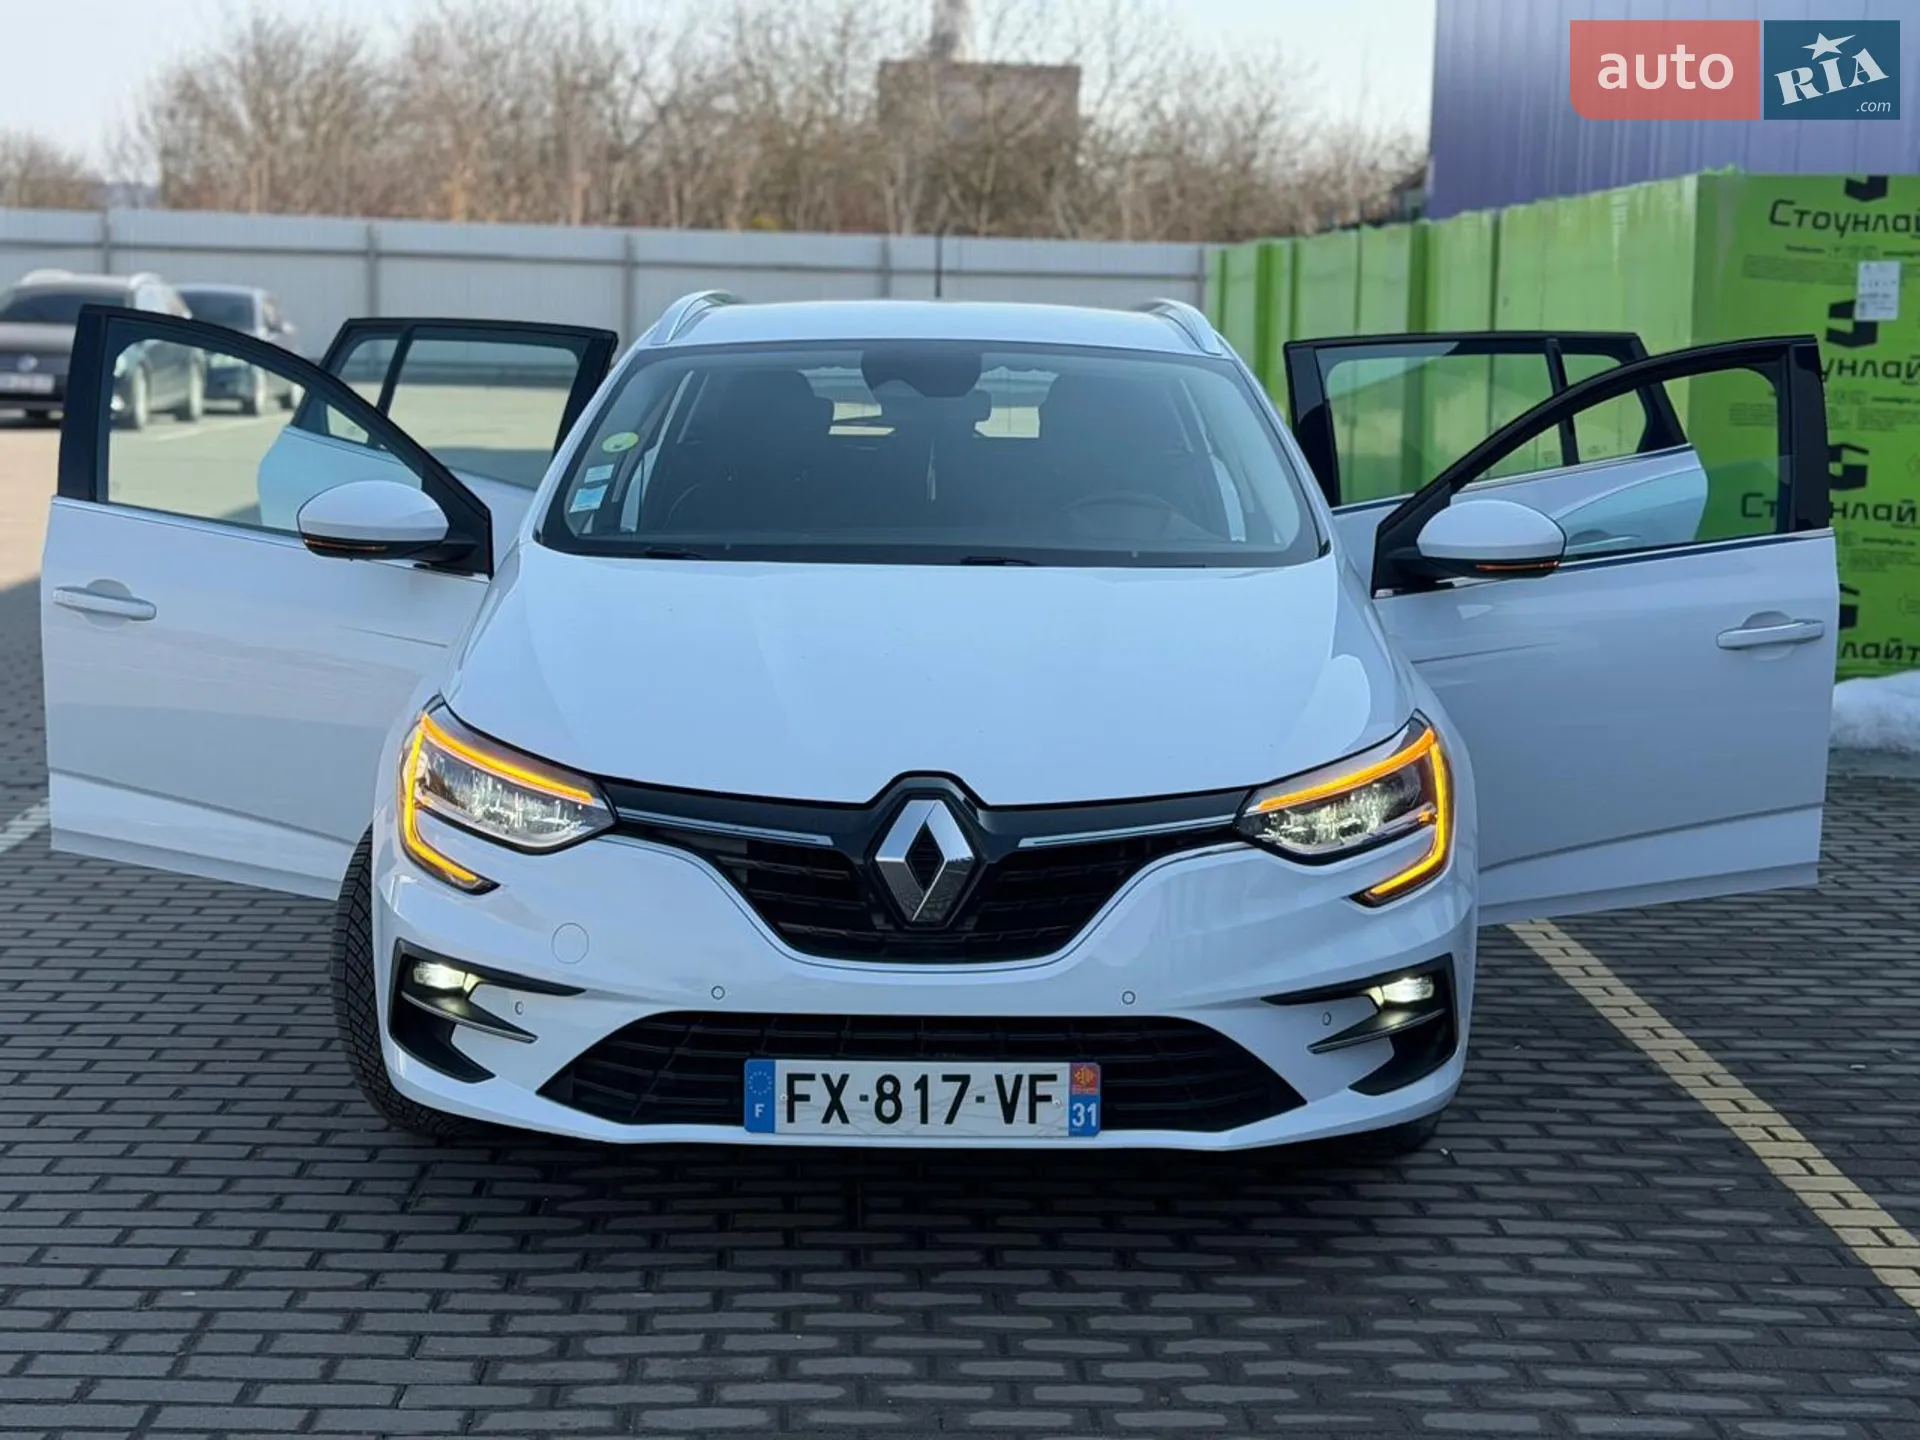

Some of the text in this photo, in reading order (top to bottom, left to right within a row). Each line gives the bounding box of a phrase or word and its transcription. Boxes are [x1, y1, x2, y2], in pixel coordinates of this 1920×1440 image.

[1768, 198, 1920, 239] Стоунла
[754, 1103, 765, 1118] F
[786, 1073, 1097, 1128] FX-817-VF 31
